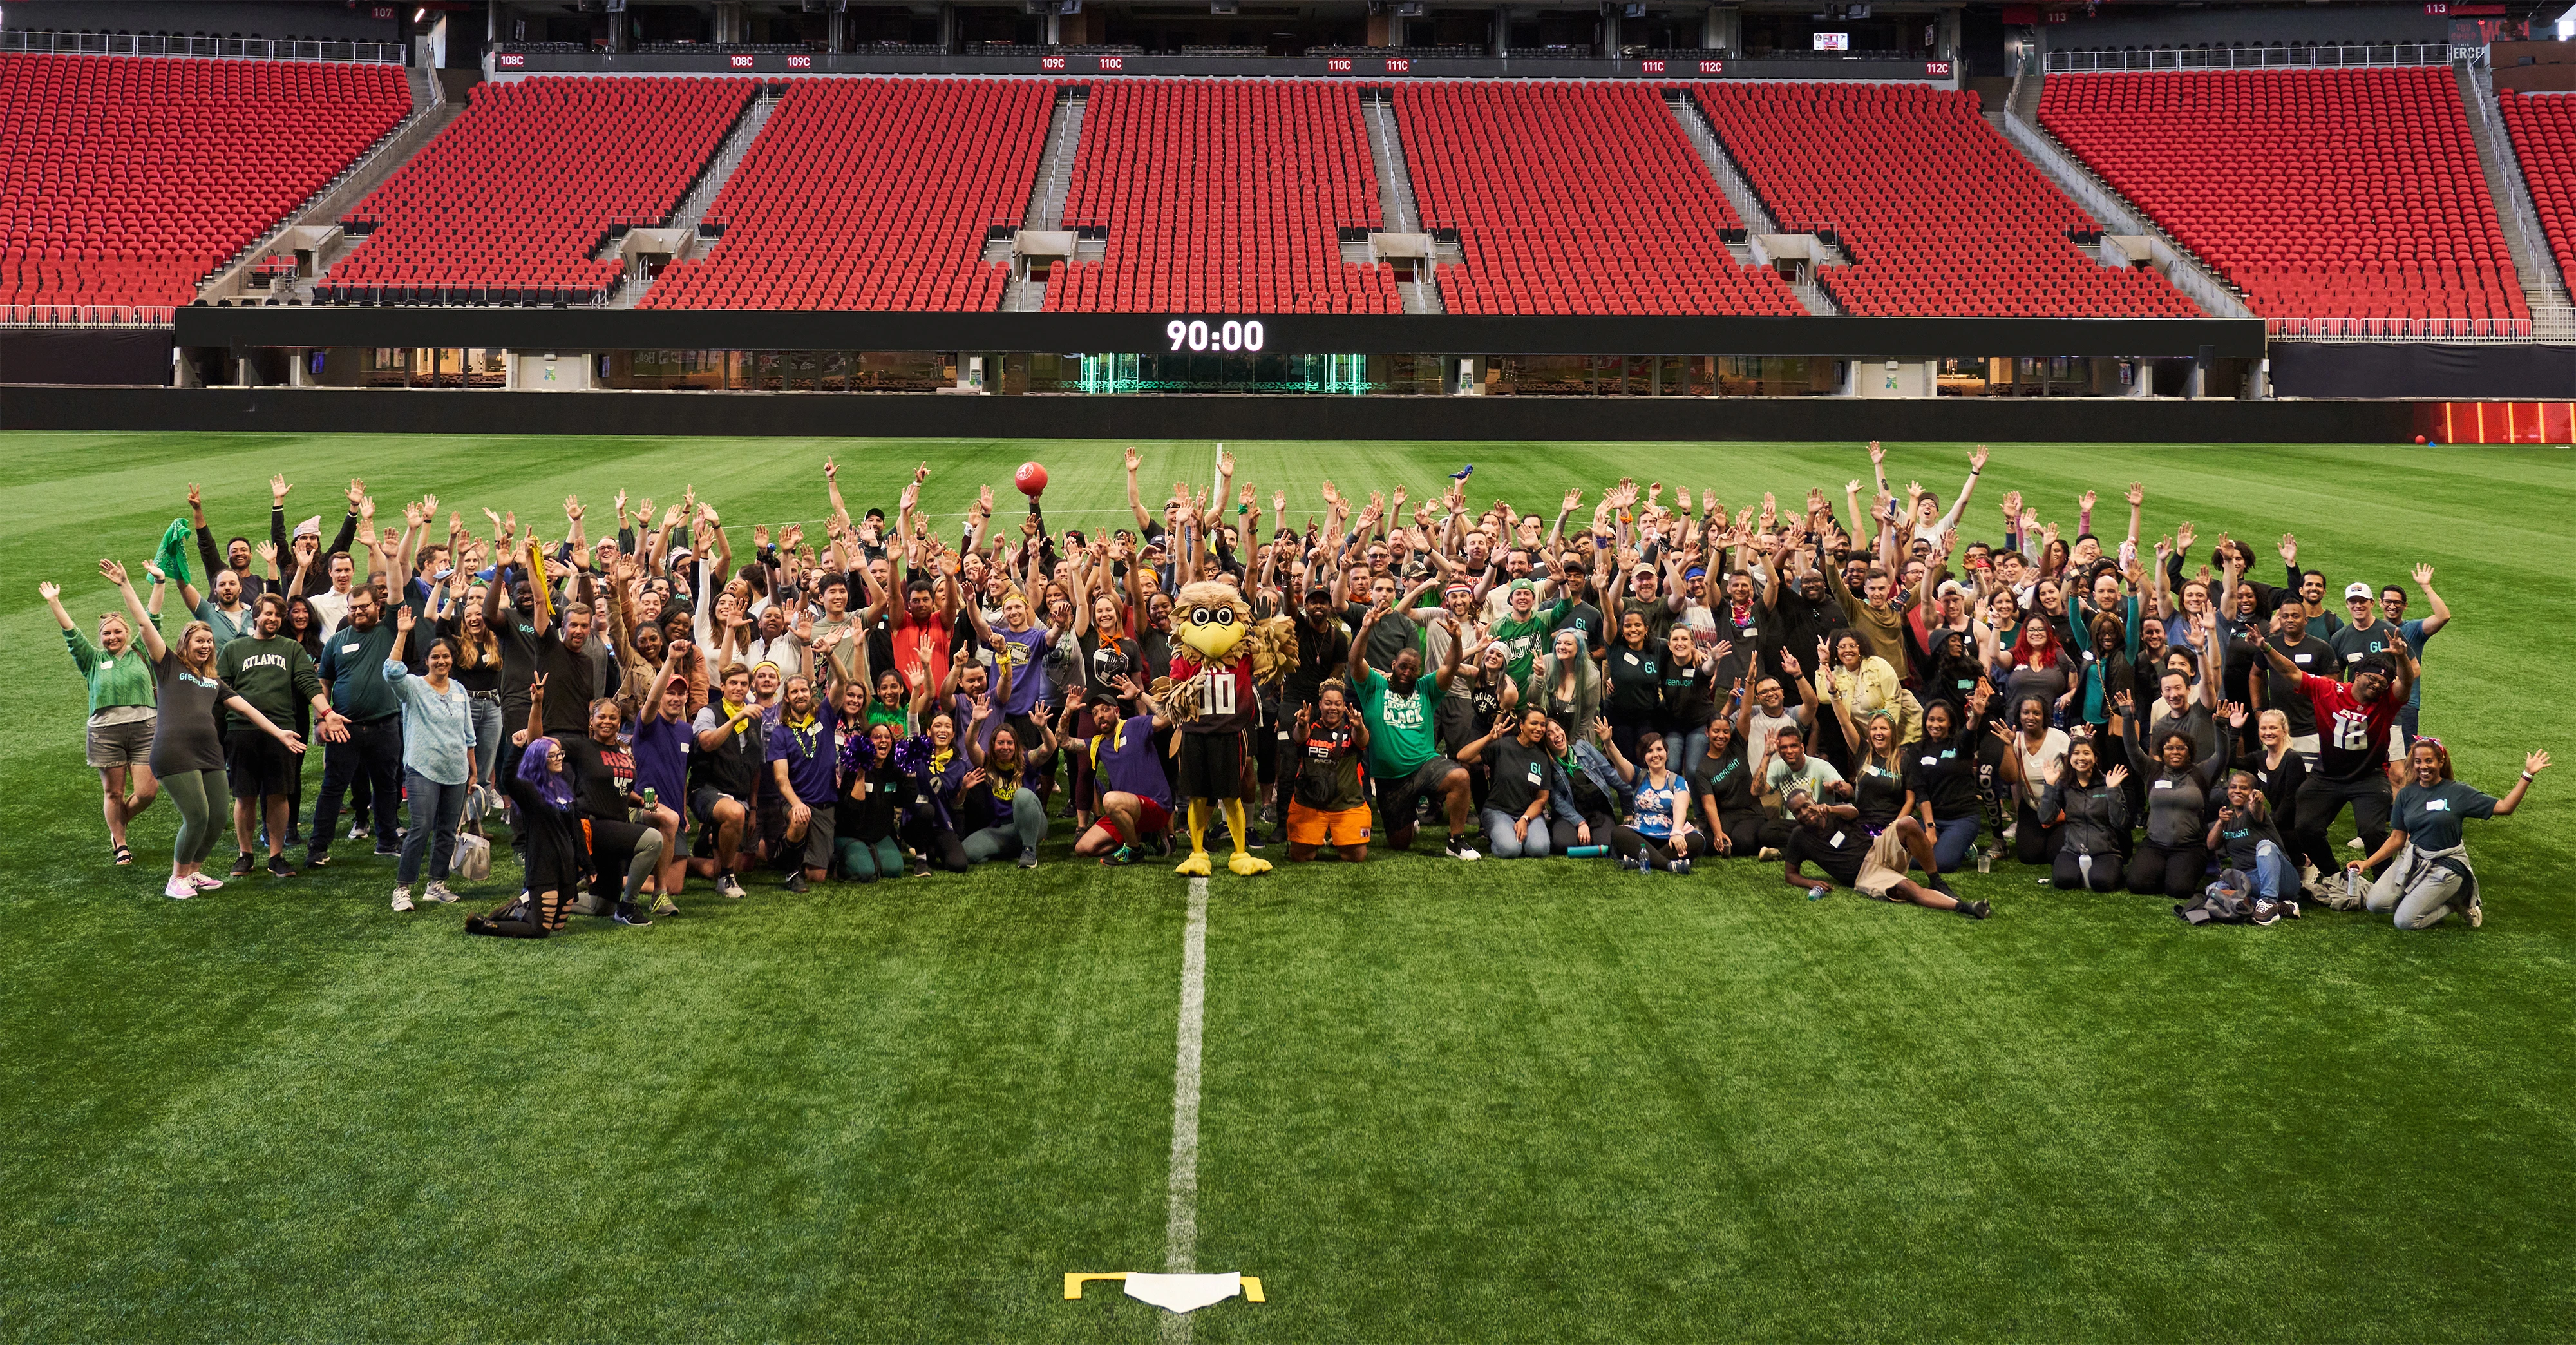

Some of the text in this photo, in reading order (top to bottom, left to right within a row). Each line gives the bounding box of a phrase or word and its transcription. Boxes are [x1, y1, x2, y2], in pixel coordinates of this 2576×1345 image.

[374, 8, 392, 17] 107
[2427, 5, 2445, 13] 113
[2049, 13, 2066, 21] 113
[501, 56, 524, 65] 108C
[732, 57, 753, 66] 108C
[788, 57, 810, 66] 109C
[1043, 59, 1065, 68] 109C
[1100, 59, 1121, 68] 110C
[1329, 60, 1350, 70] 110C
[1387, 61, 1408, 70] 111C
[1643, 62, 1664, 72] 111C
[1700, 62, 1721, 72] 112C
[1927, 64, 1948, 73] 112C
[1167, 320, 1265, 352] 90:00
[1576, 618, 1587, 631] GL
[2370, 641, 2383, 653] GL
[242, 654, 287, 672] ATLANTA
[1644, 662, 1657, 674] GL
[1383, 705, 1424, 724] BLACK
[2332, 711, 2368, 750] 18
[1530, 762, 1542, 776] GL
[1979, 764, 2000, 827] adidas
